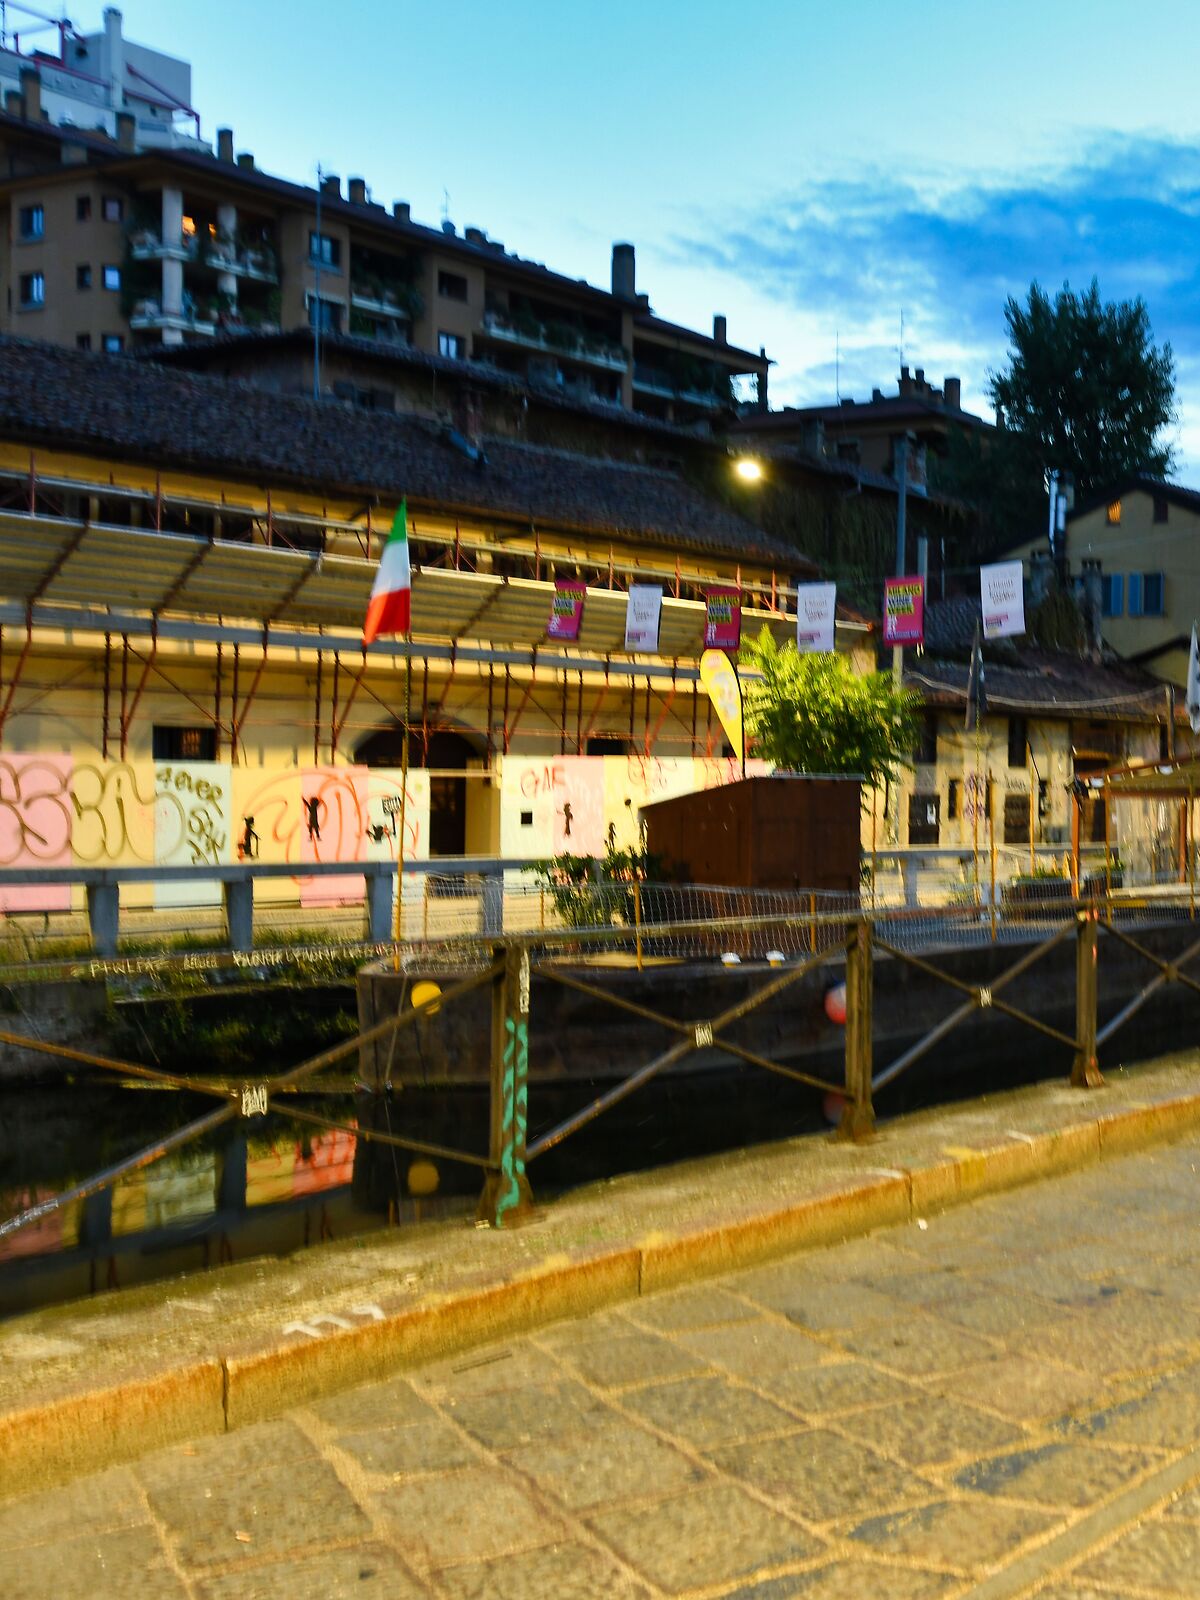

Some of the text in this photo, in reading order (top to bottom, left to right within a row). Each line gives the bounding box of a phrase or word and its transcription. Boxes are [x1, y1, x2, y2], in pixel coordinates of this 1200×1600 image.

[887, 584, 921, 596] MILANO
[554, 599, 573, 608] WINE
[708, 596, 739, 607] MILANO
[888, 594, 912, 606] WINE
[708, 604, 730, 615] WINE
[887, 604, 914, 615] WEEK
[708, 614, 731, 624] WEEK
